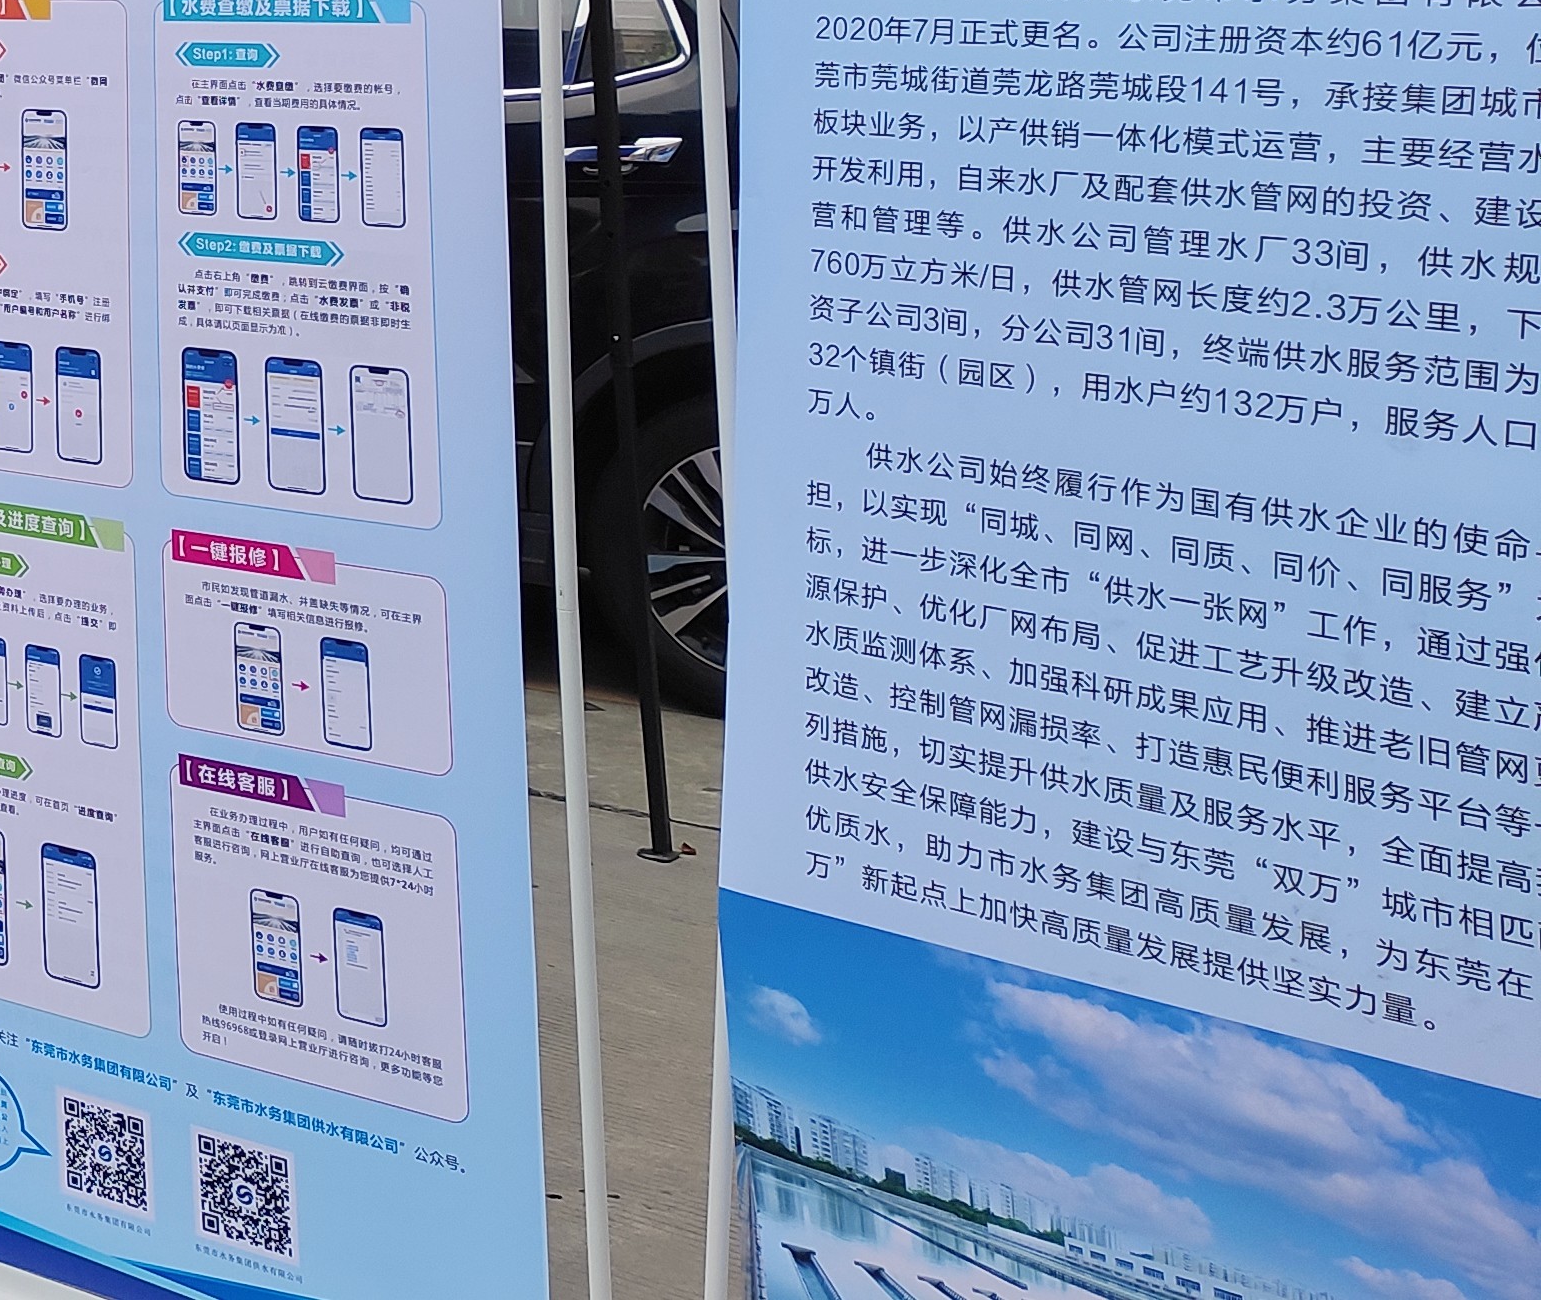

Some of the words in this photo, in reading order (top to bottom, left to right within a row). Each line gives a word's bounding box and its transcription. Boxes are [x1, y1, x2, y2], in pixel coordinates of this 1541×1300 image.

[810, 200, 1541, 285] 营和管理等。供水公司管理水厂33间，供水规
[810, 247, 1541, 341] 760万立方米/日，供水管网长度约2.3万公里，下
[806, 389, 879, 424] 万人。
[808, 342, 1538, 452] 32个镇街（园区），用水户约132万户，服务人口
[809, 294, 1541, 397] 资子公司3间，分公司31间，终端供水服务范围为
[178, 535, 280, 571] 【一键报修】
[806, 479, 1541, 621] 担，以实现“同城、同网、同质、同价、同服务”
[865, 441, 1541, 562] 供水公司始终履行作为国有供水企业的使命
[805, 526, 1541, 676] 标，进一步深化全市“供水一张网”工作，通过强
[805, 573, 1541, 732] 源保护、优化厂网布局、促进工艺升级改造、建立
[805, 619, 1541, 788] 水质监测体系、加强科研成果应用、推进老旧管网
[805, 666, 1541, 838] 改造、控制管网漏损率、打造惠民便利服务平台等
[185, 760, 289, 801] 【在线客服】
[805, 711, 1541, 897] 列措施，切实提升供水质量及服务水平，全面提高
[194, 850, 218, 866] 服务。
[805, 759, 1541, 949] 供水安全保障能力，建设与东莞“双万”城市相匹
[805, 806, 1535, 1000] 优质水，助力市水务集团高质量发展，为东莞在
[805, 850, 1437, 1032] 万”新起点上加快高质量发展提供坚实力量。
